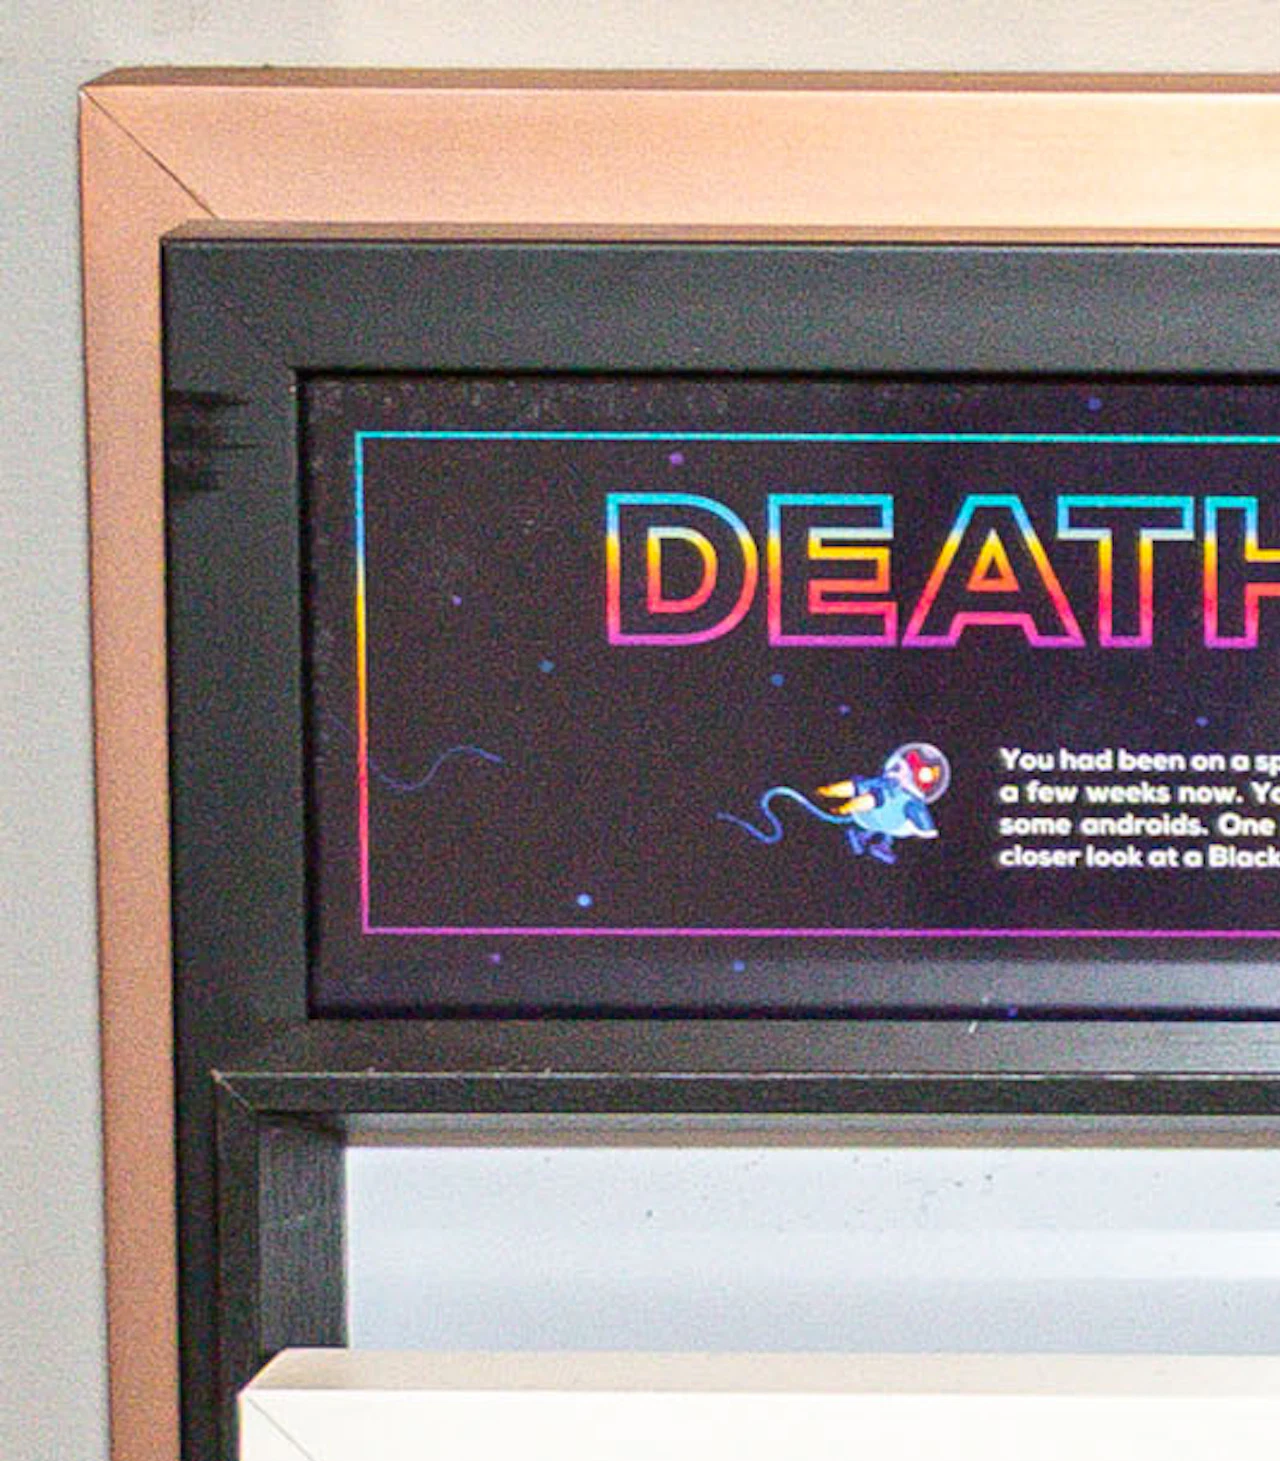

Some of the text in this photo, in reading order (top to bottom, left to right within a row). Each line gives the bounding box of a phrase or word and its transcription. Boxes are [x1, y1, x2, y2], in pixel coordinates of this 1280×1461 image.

[1000, 748, 1055, 771] You
[1059, 748, 1113, 771] had
[1117, 749, 1186, 772] been
[1190, 753, 1226, 772] on
[1230, 753, 1250, 772] a
[998, 784, 1019, 803] a
[1025, 780, 1079, 803] few
[1085, 781, 1171, 804] weeks
[1178, 785, 1244, 804] now.
[998, 817, 1073, 836] some
[1079, 814, 1209, 837] androids.
[1216, 814, 1277, 837] One
[998, 845, 1082, 868] closer
[1085, 846, 1143, 869] look
[1147, 846, 1179, 869] at
[1182, 850, 1203, 869] a
